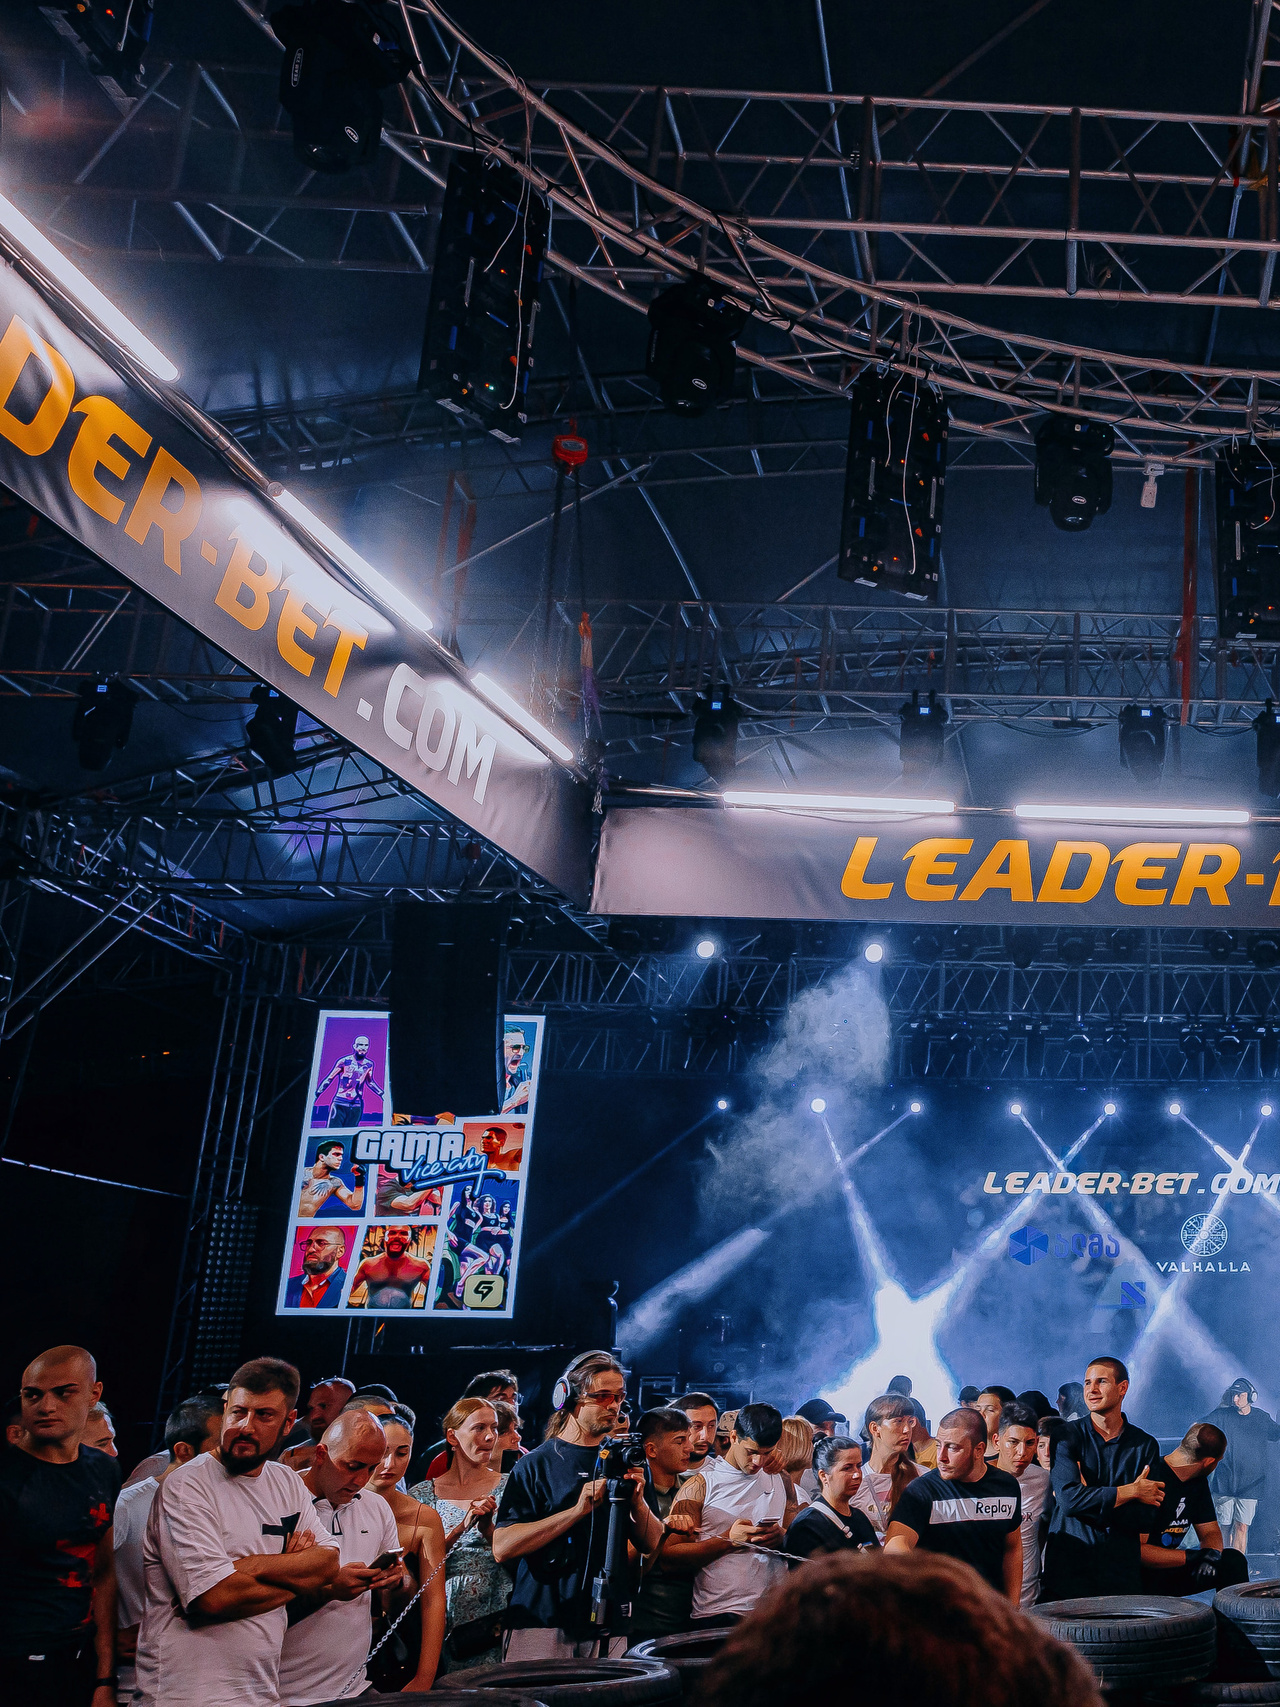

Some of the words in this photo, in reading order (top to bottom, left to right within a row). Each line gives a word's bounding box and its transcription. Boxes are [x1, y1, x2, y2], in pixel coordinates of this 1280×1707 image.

[355, 1131, 464, 1169] GAMA
[403, 1154, 443, 1182] Vice
[1156, 1262, 1251, 1273] VALHALLA
[976, 1499, 1012, 1517] Replay
